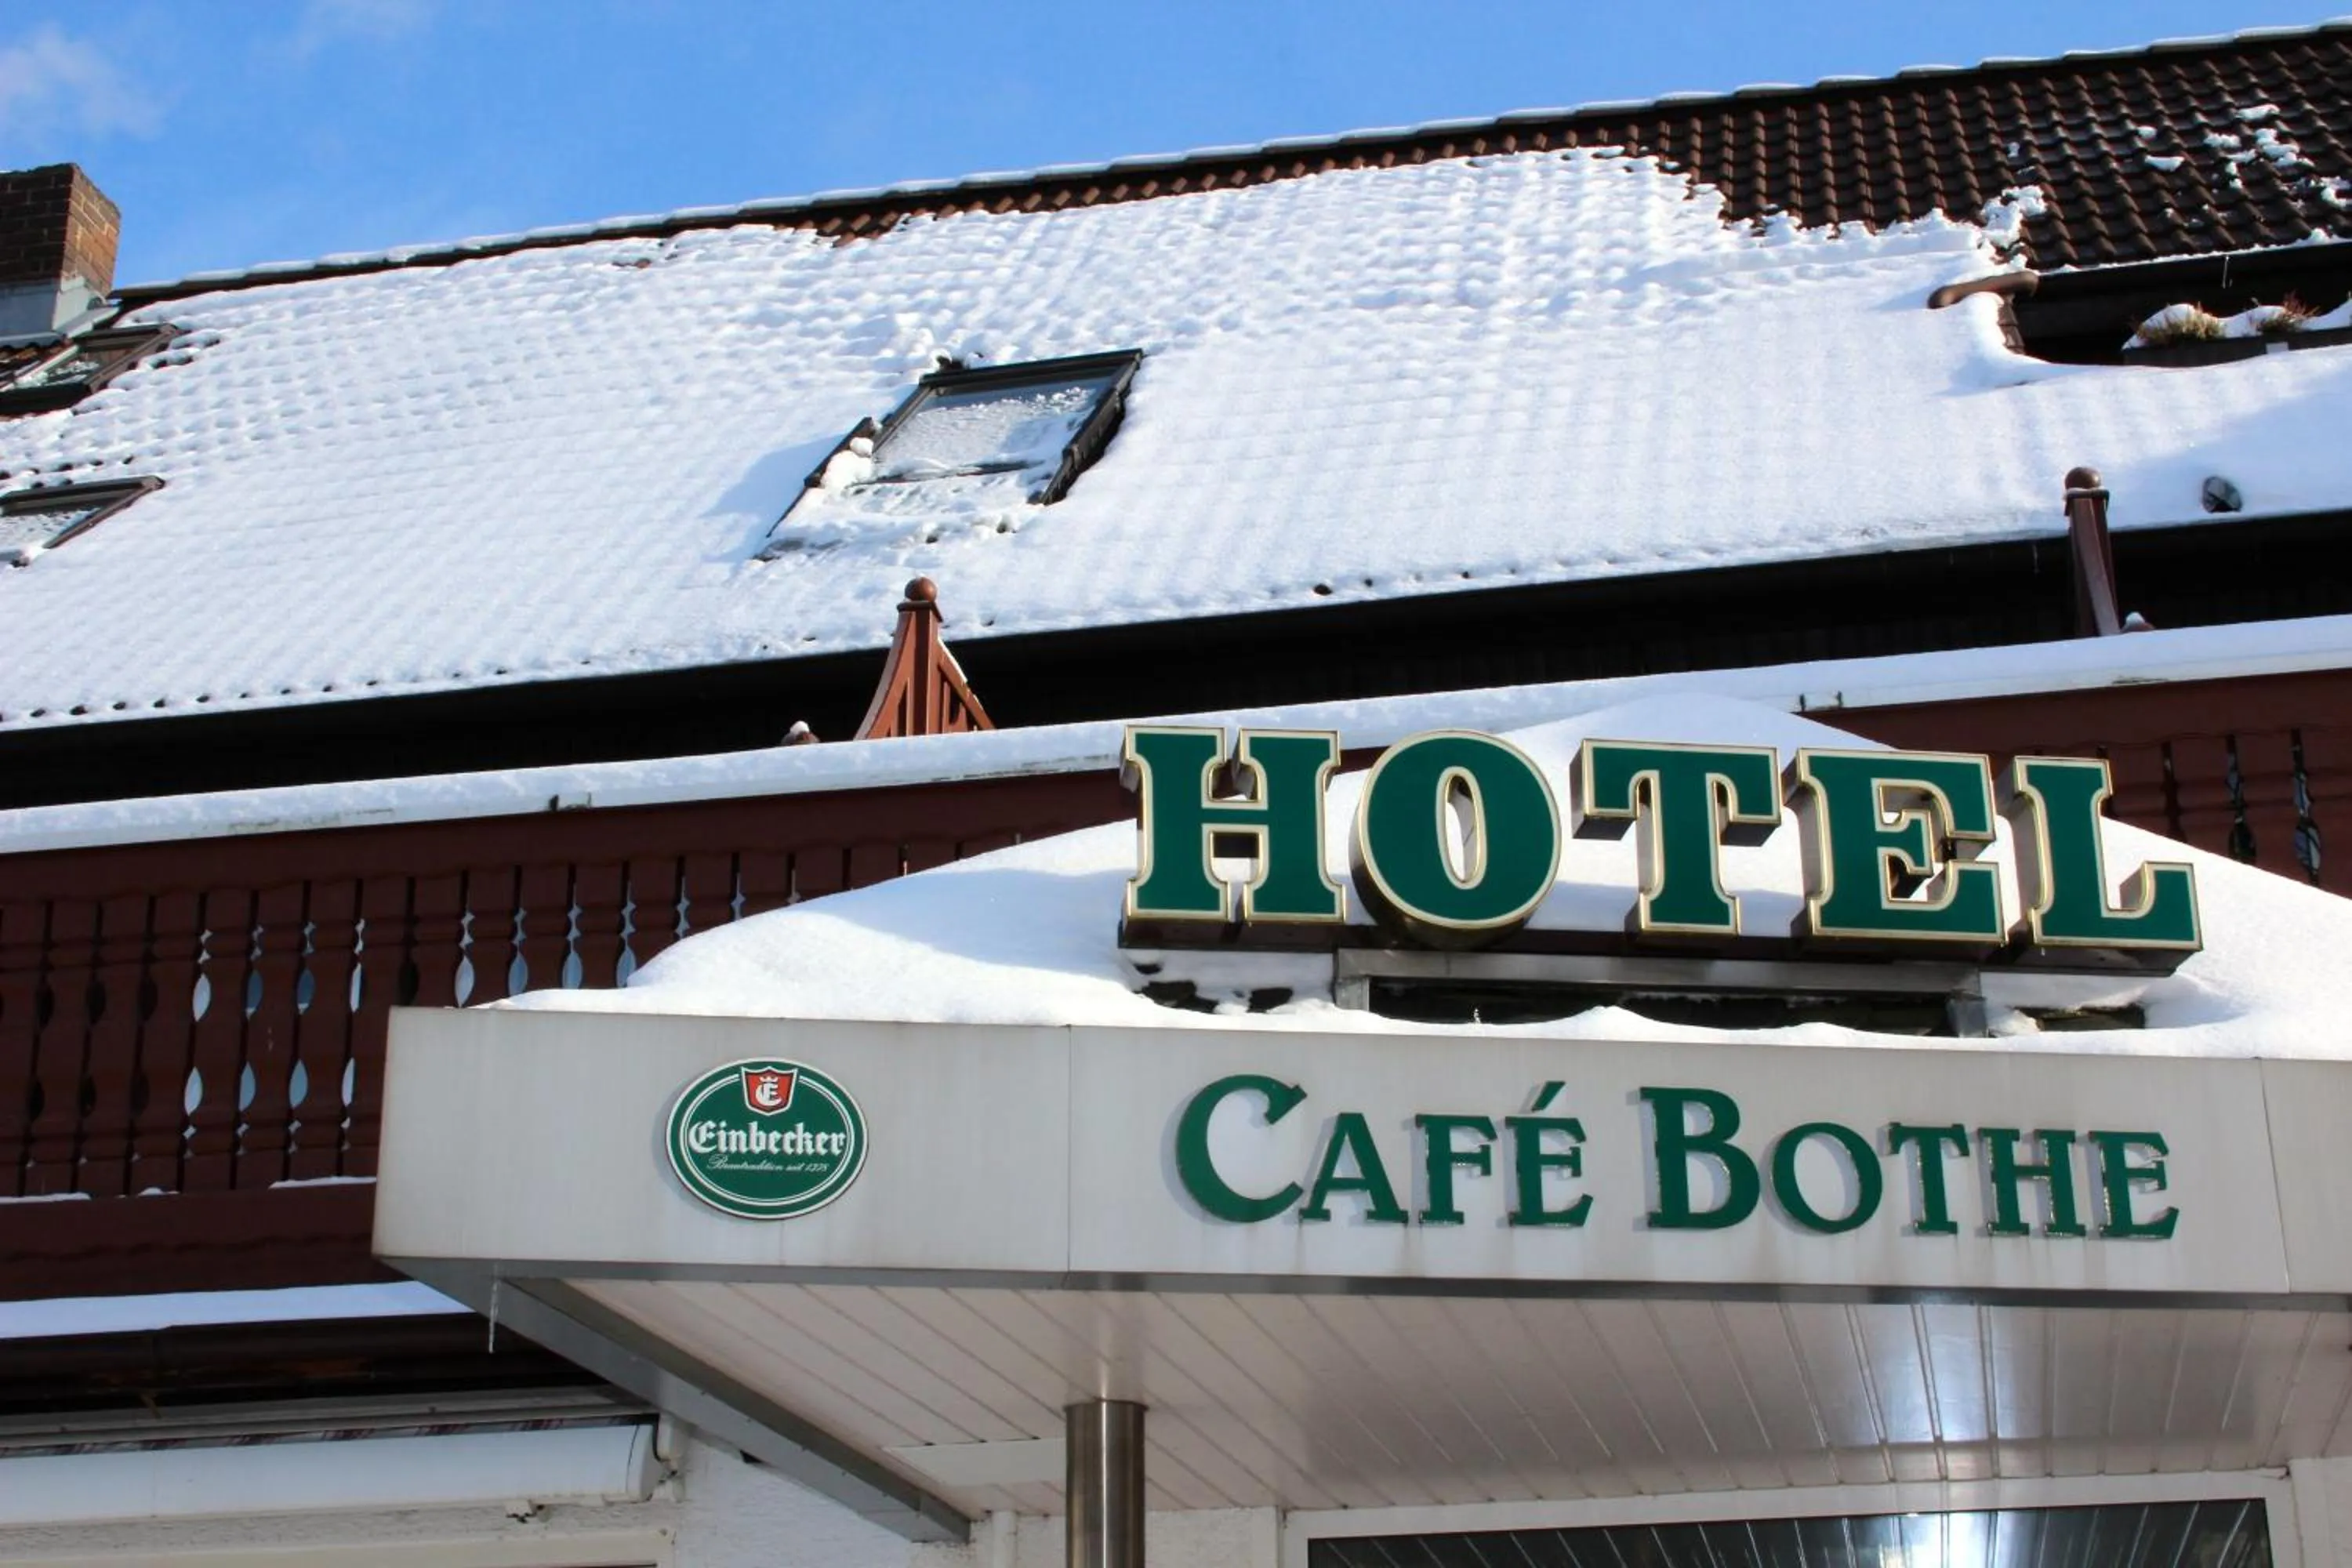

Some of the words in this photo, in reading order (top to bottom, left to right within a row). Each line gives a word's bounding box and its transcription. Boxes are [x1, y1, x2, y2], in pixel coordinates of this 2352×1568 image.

[1121, 725, 2202, 950] HOTEL
[688, 1120, 845, 1155] Einbecker
[1176, 1074, 1593, 1229] CAFÉ
[1639, 1086, 2180, 1240] BOTHE
